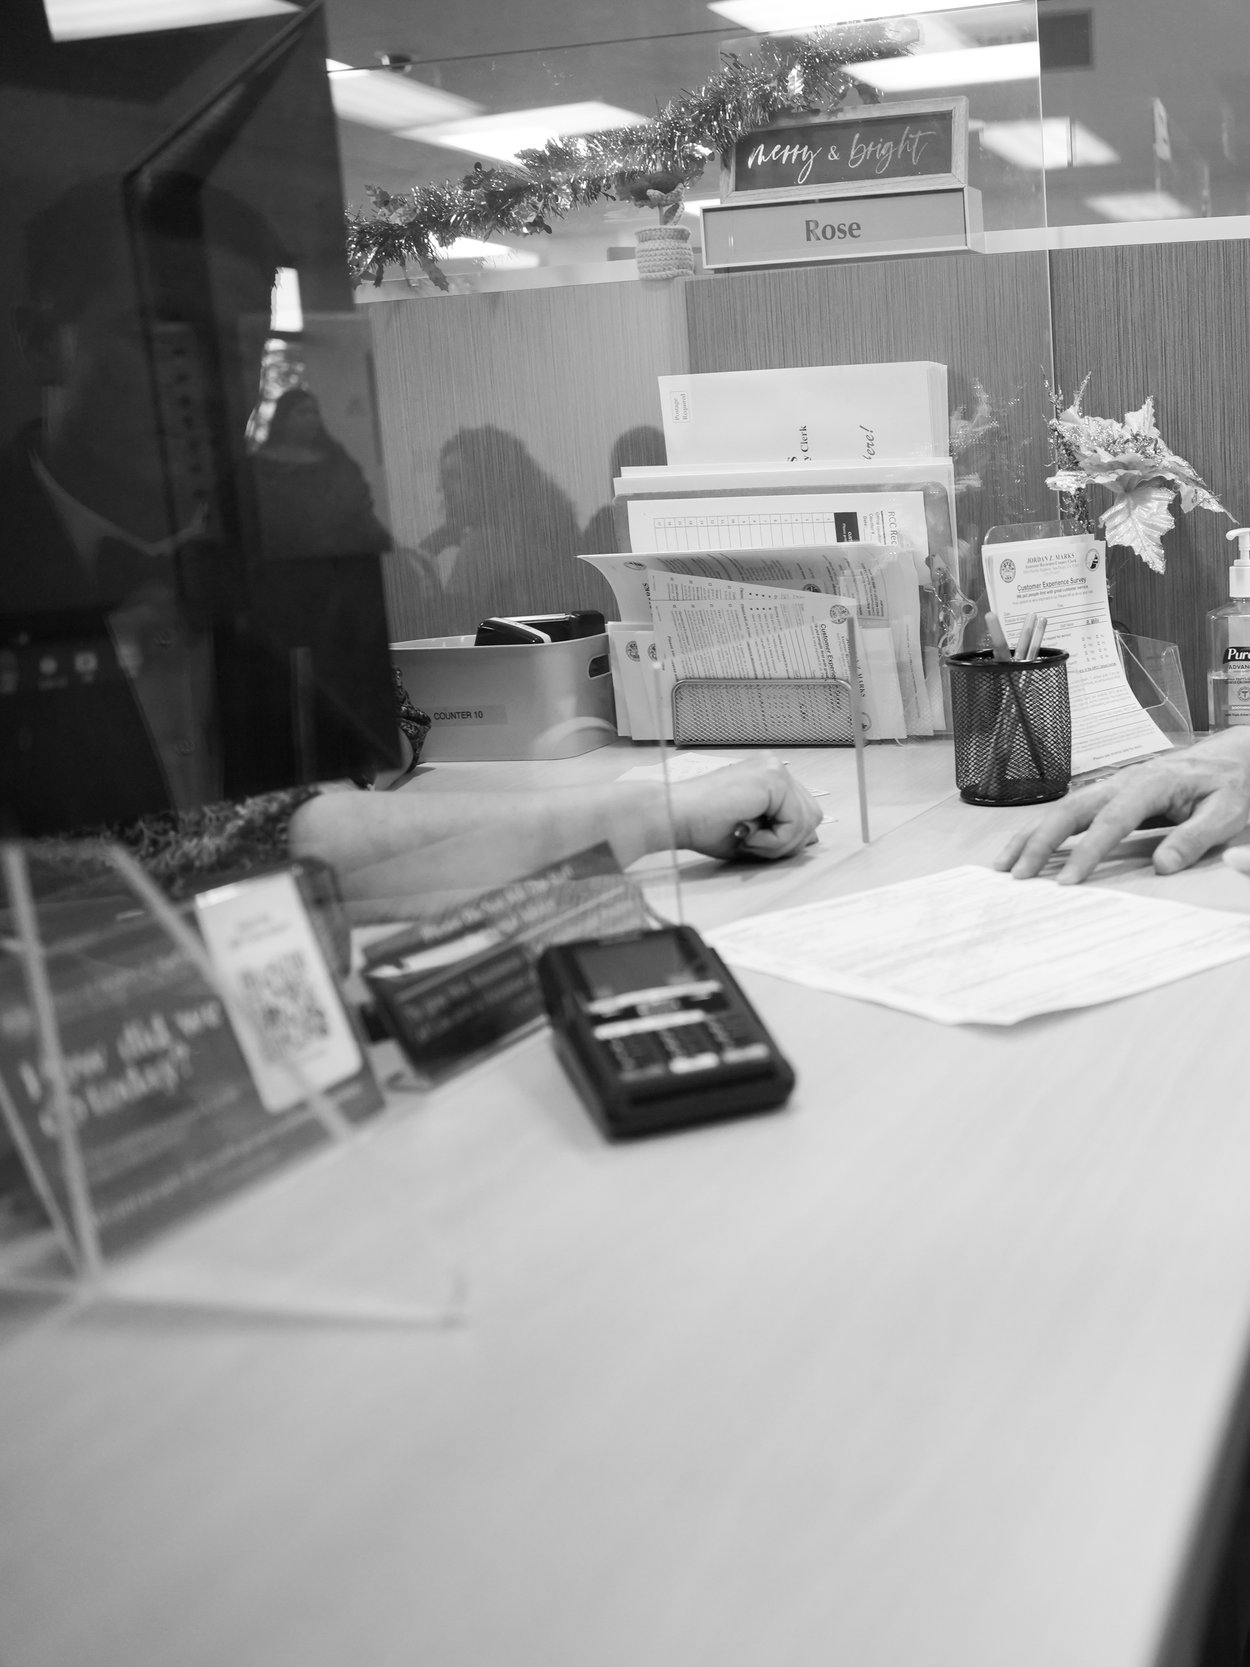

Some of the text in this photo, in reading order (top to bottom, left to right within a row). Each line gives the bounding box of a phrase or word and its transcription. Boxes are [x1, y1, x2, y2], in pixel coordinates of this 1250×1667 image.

[748, 126, 936, 184] merry & bright
[805, 218, 862, 242] Rose
[799, 425, 809, 453] Clerk
[888, 511, 897, 528] RCC
[1017, 577, 1087, 591] Customer Experience Survey
[820, 623, 831, 654] Customer
[433, 710, 484, 720] COUNTER 10
